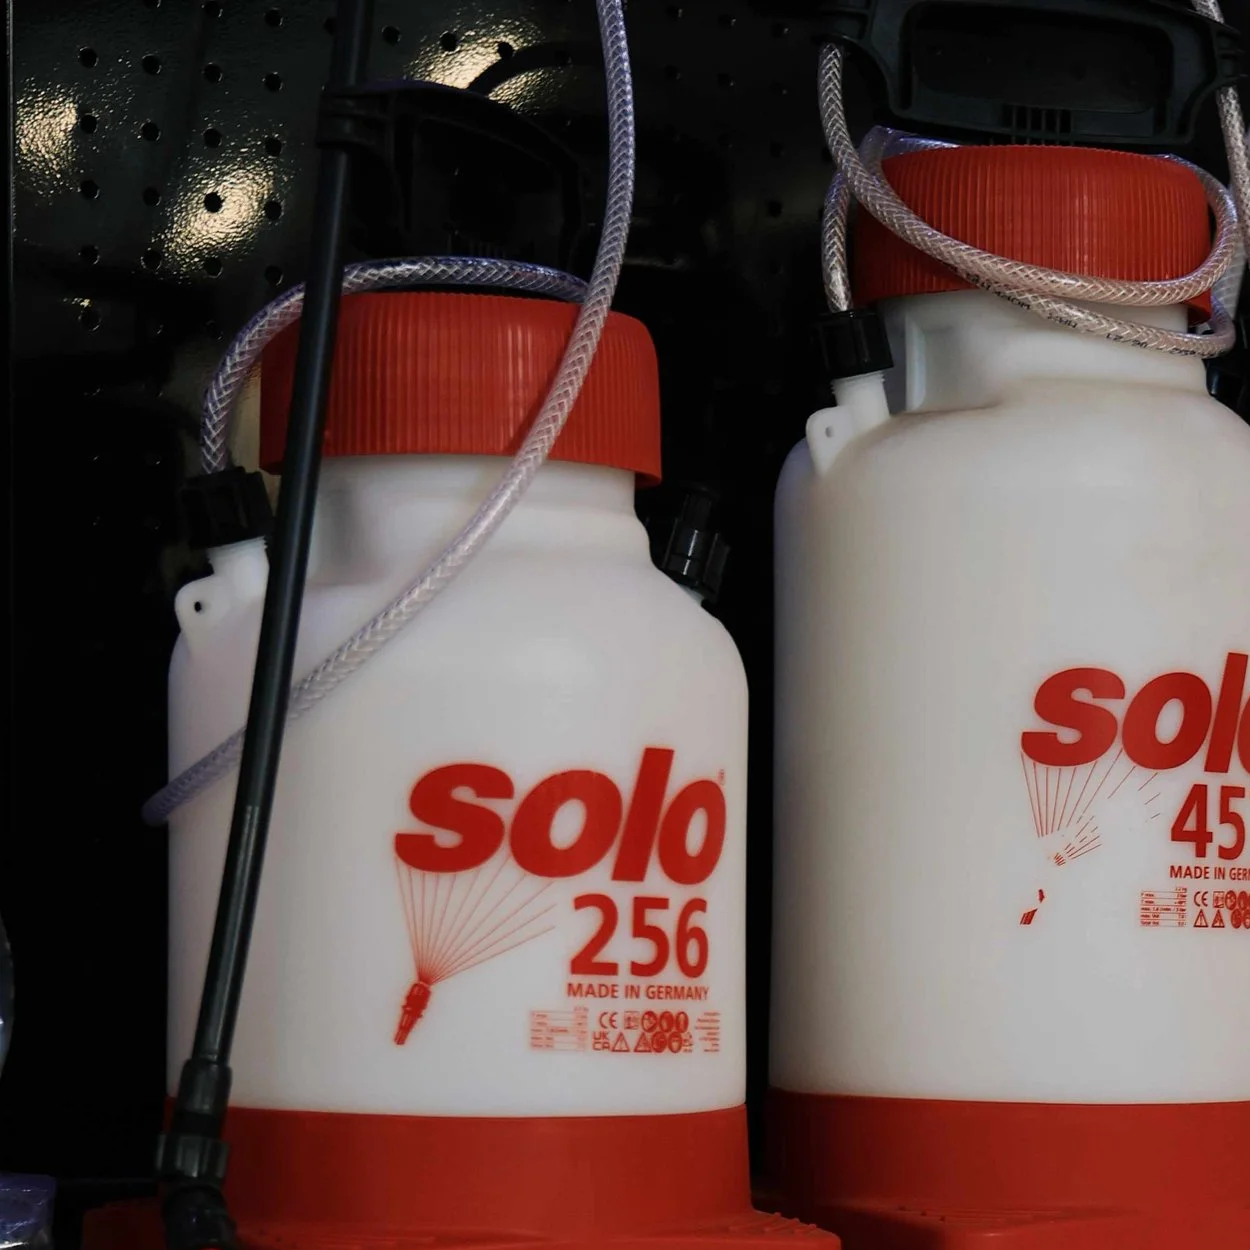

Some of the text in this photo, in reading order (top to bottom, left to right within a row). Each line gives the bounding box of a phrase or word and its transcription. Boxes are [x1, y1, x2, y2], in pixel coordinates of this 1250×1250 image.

[394, 747, 726, 885] solo
[1169, 865, 1210, 879] MADE
[1214, 867, 1226, 880] IN
[570, 893, 709, 979] 256
[567, 983, 709, 1000] MADE IN GERMANY
